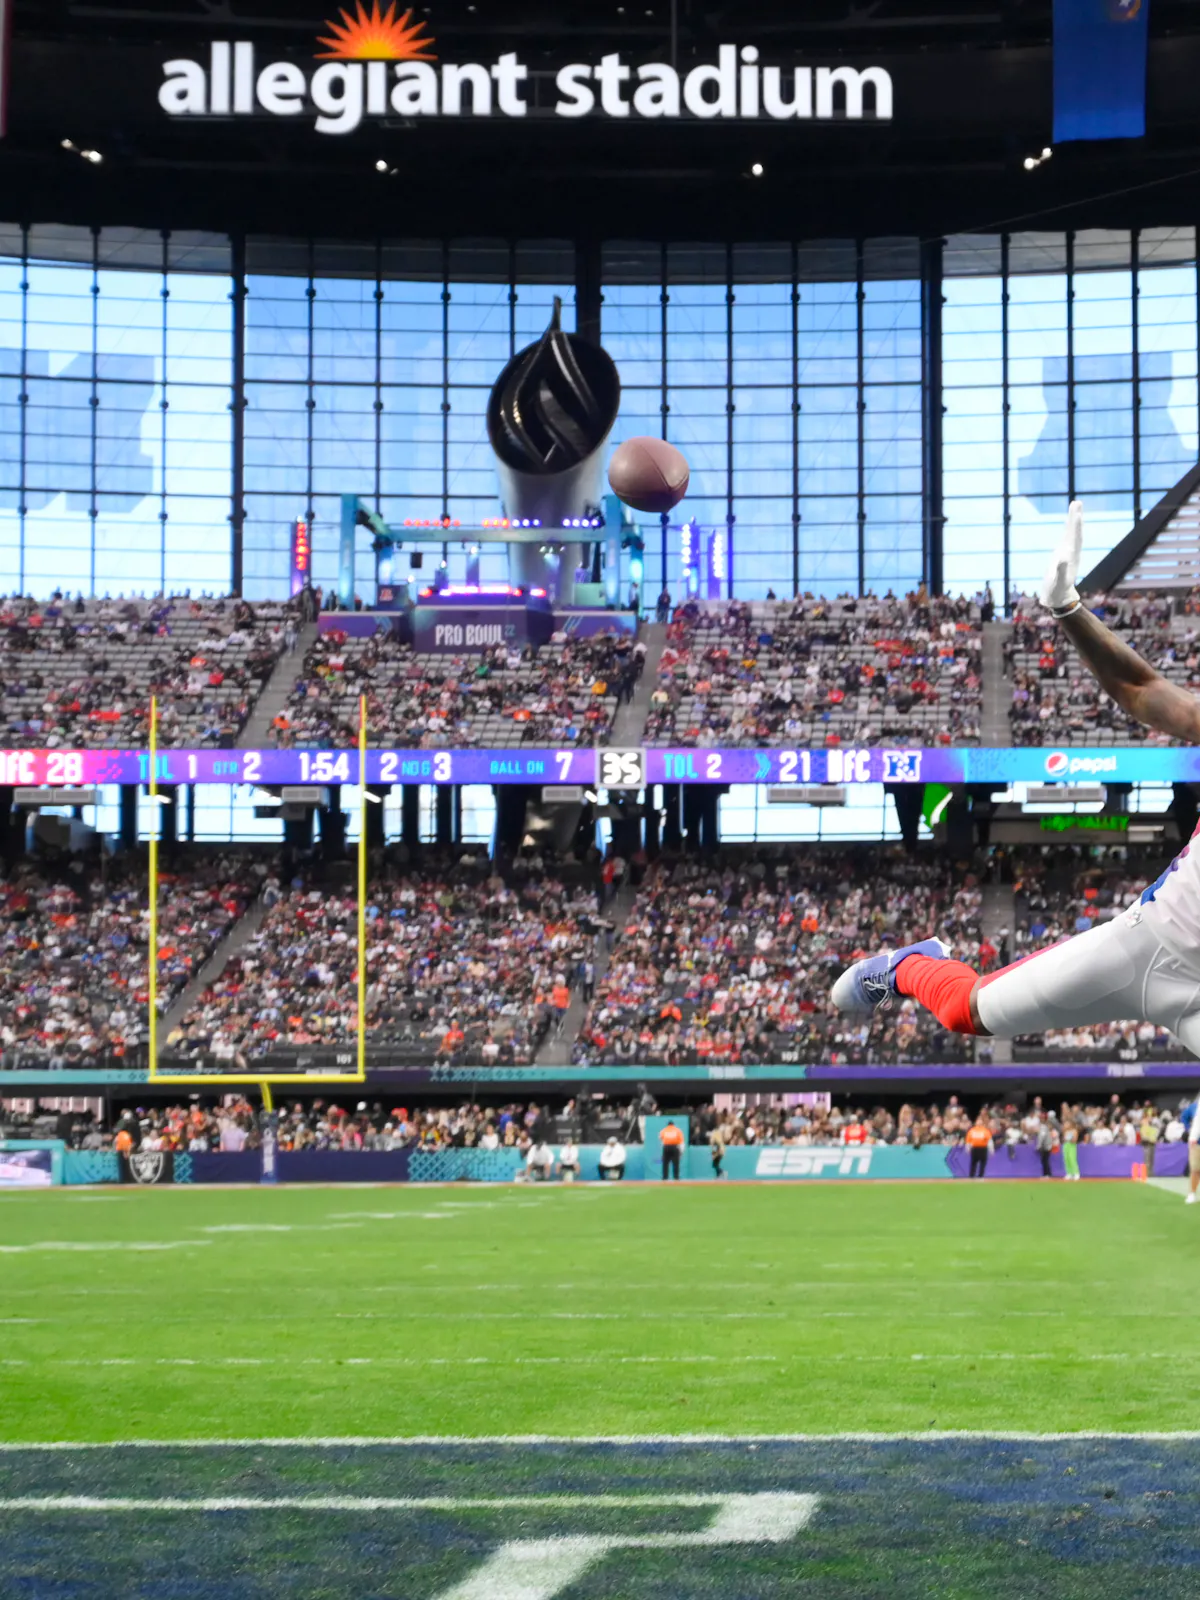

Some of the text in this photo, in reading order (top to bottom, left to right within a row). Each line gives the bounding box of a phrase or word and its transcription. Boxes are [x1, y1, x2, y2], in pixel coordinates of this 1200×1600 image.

[158, 41, 892, 135] allegiant stadium
[435, 624, 463, 646] PRO
[465, 624, 506, 646] BOWL
[46, 751, 83, 782] 28
[188, 754, 197, 779] 1
[243, 752, 262, 781] 2
[300, 752, 350, 781] 1:54
[380, 752, 398, 780] 2
[433, 752, 452, 781] 3
[490, 761, 524, 776] BALL
[527, 760, 545, 776] ON
[556, 751, 574, 781] 7
[603, 752, 641, 784] 35
[663, 753, 697, 779] TOL
[706, 753, 722, 779] 2
[779, 752, 811, 782] 21
[827, 751, 870, 781] NFC
[1069, 753, 1117, 775] pepsi
[755, 1147, 873, 1177] ESPN
